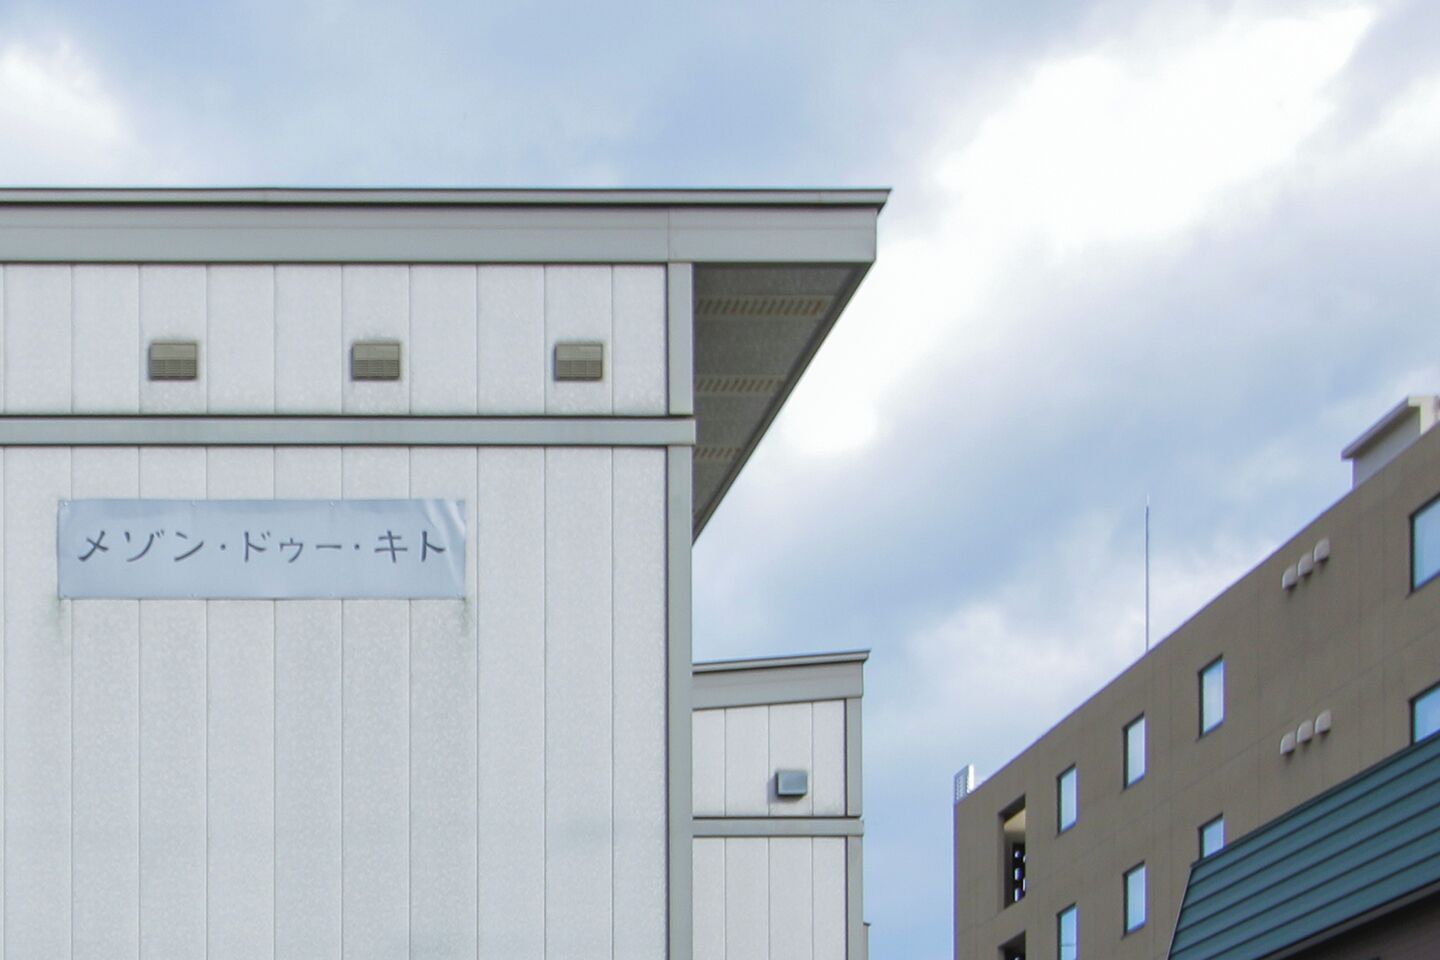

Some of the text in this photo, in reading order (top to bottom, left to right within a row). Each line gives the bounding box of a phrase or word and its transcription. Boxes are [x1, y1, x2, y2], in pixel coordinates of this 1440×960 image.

[77, 528, 447, 563] メゾン・ドゥー・キト
